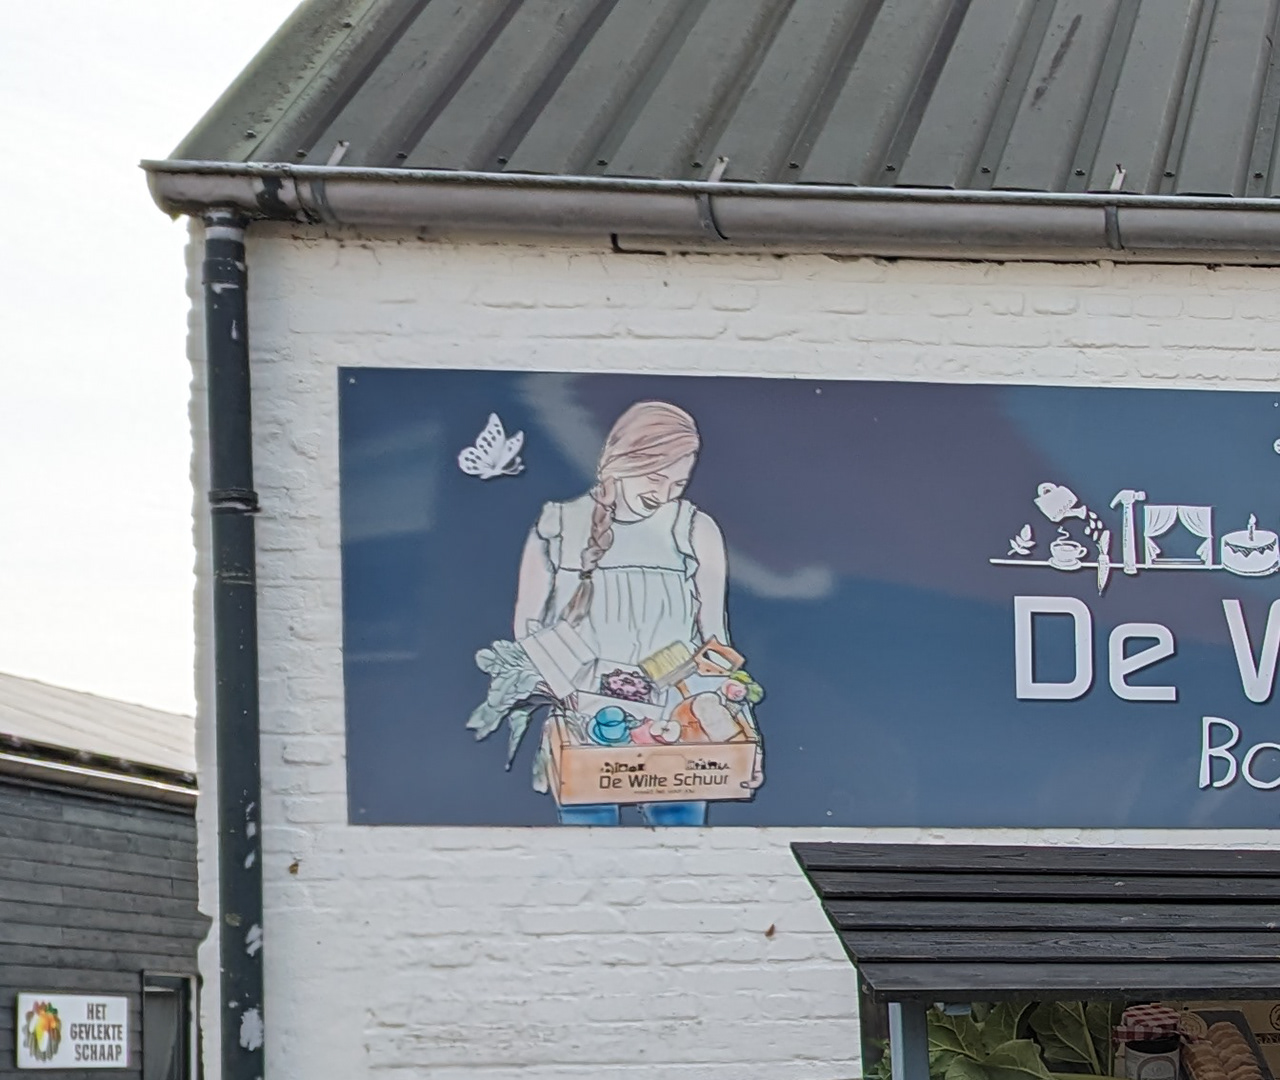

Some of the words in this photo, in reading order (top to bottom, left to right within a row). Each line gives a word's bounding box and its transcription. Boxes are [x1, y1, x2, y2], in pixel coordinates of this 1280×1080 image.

[1013, 595, 1178, 702] De
[599, 774, 623, 789] De
[628, 773, 668, 788] Witte
[673, 772, 729, 787] Schuur
[86, 1003, 107, 1021] HET
[70, 1023, 123, 1041] GEVLEKTE
[75, 1044, 122, 1061] SCHAAP
